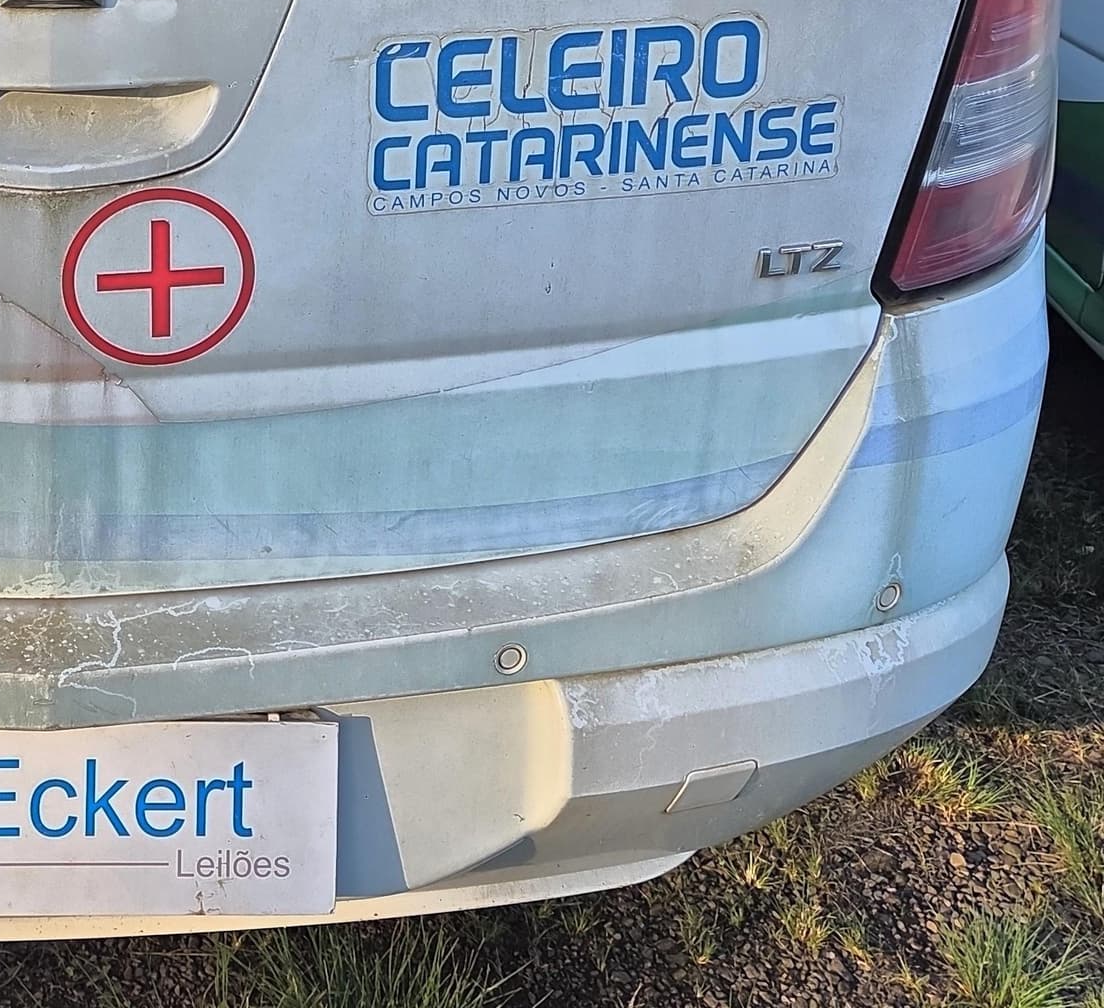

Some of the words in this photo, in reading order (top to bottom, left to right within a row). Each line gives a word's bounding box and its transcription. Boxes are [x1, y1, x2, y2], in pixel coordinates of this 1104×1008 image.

[374, 19, 762, 123] CELEIRO
[372, 101, 838, 192] CATARINENSE
[372, 188, 482, 212] CAMPOS
[497, 181, 587, 203] NOVOS
[621, 171, 701, 192] SANTA
[712, 159, 832, 184] CATARINA
[757, 239, 845, 280] LTZ
[176, 849, 291, 879] Leilões
